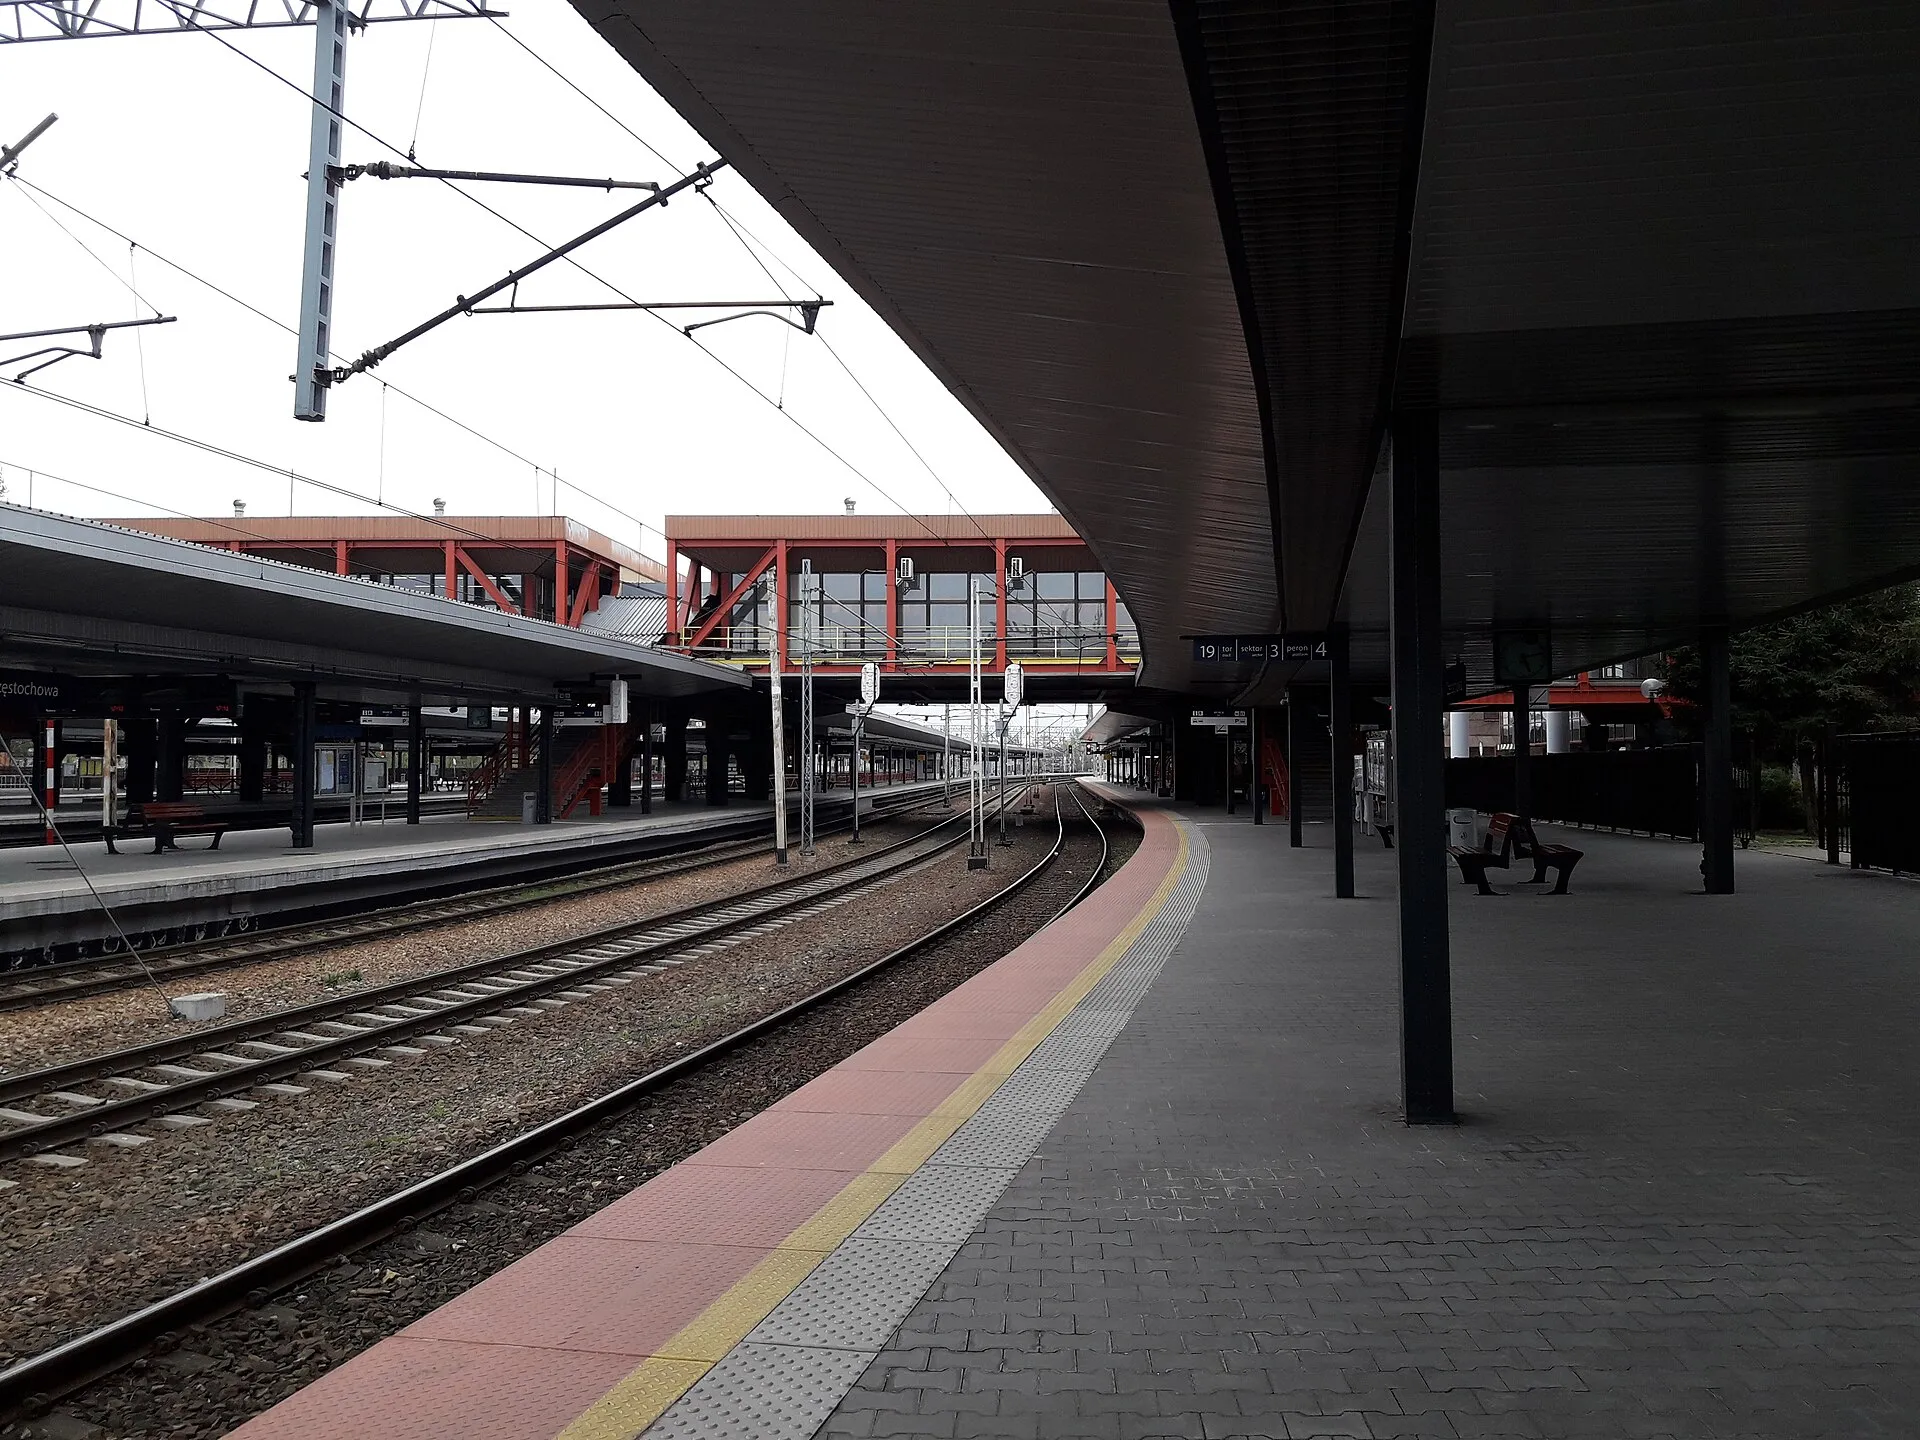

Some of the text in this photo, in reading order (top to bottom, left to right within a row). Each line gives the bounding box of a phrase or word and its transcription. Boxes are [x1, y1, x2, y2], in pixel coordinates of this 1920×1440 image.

[1200, 645, 1215, 658] 19
[1240, 644, 1263, 652] sektor
[1270, 644, 1279, 658] 3
[1315, 641, 1327, 657] 4
